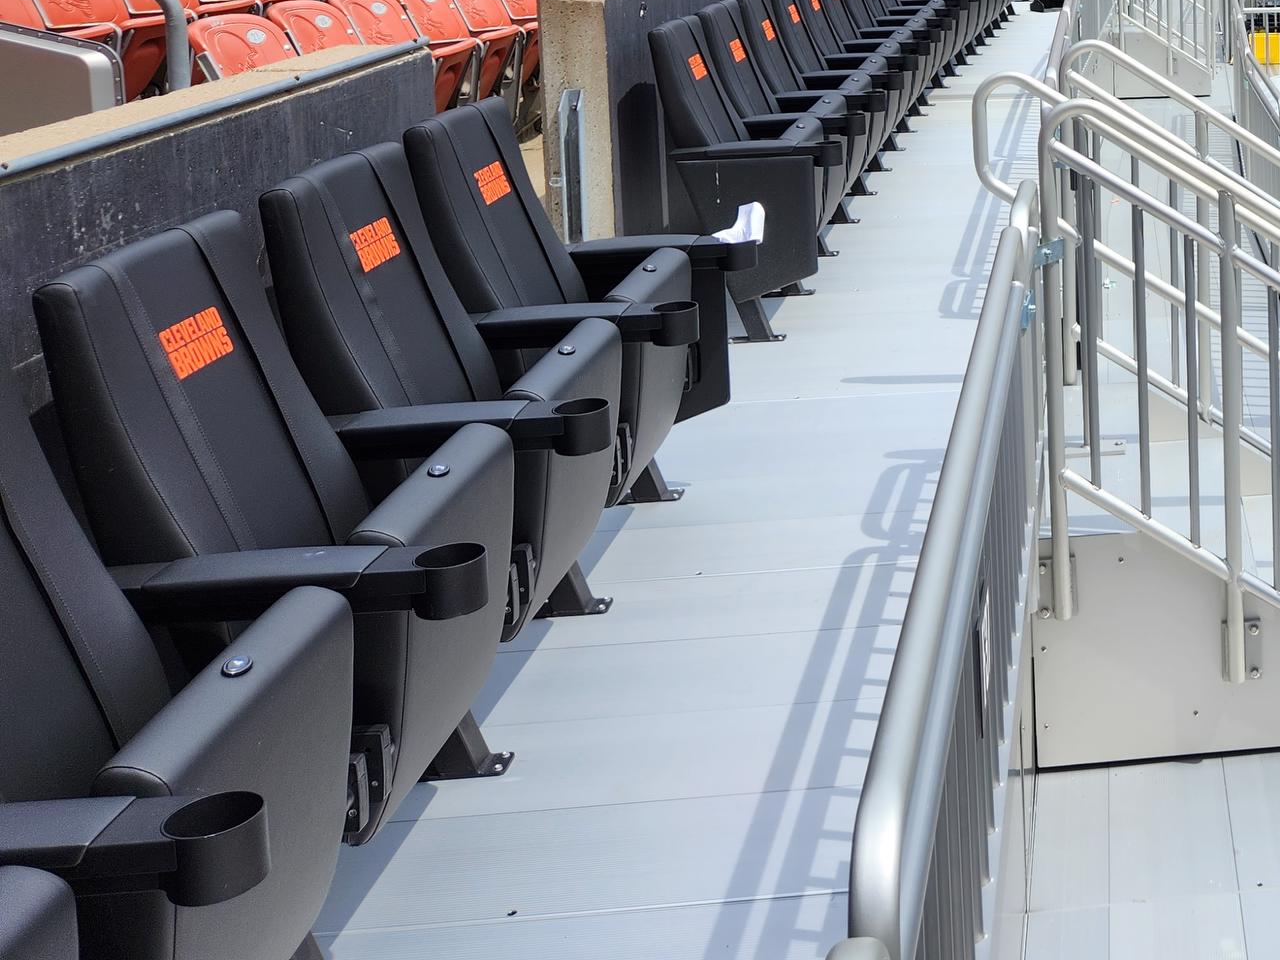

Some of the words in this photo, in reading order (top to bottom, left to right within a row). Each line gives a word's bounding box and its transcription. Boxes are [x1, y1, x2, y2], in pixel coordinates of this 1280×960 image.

[350, 217, 392, 251] CLEVELAND
[357, 233, 400, 273] BROWNS
[158, 306, 223, 354] CLEVELAND
[167, 326, 234, 381] BROWNS
